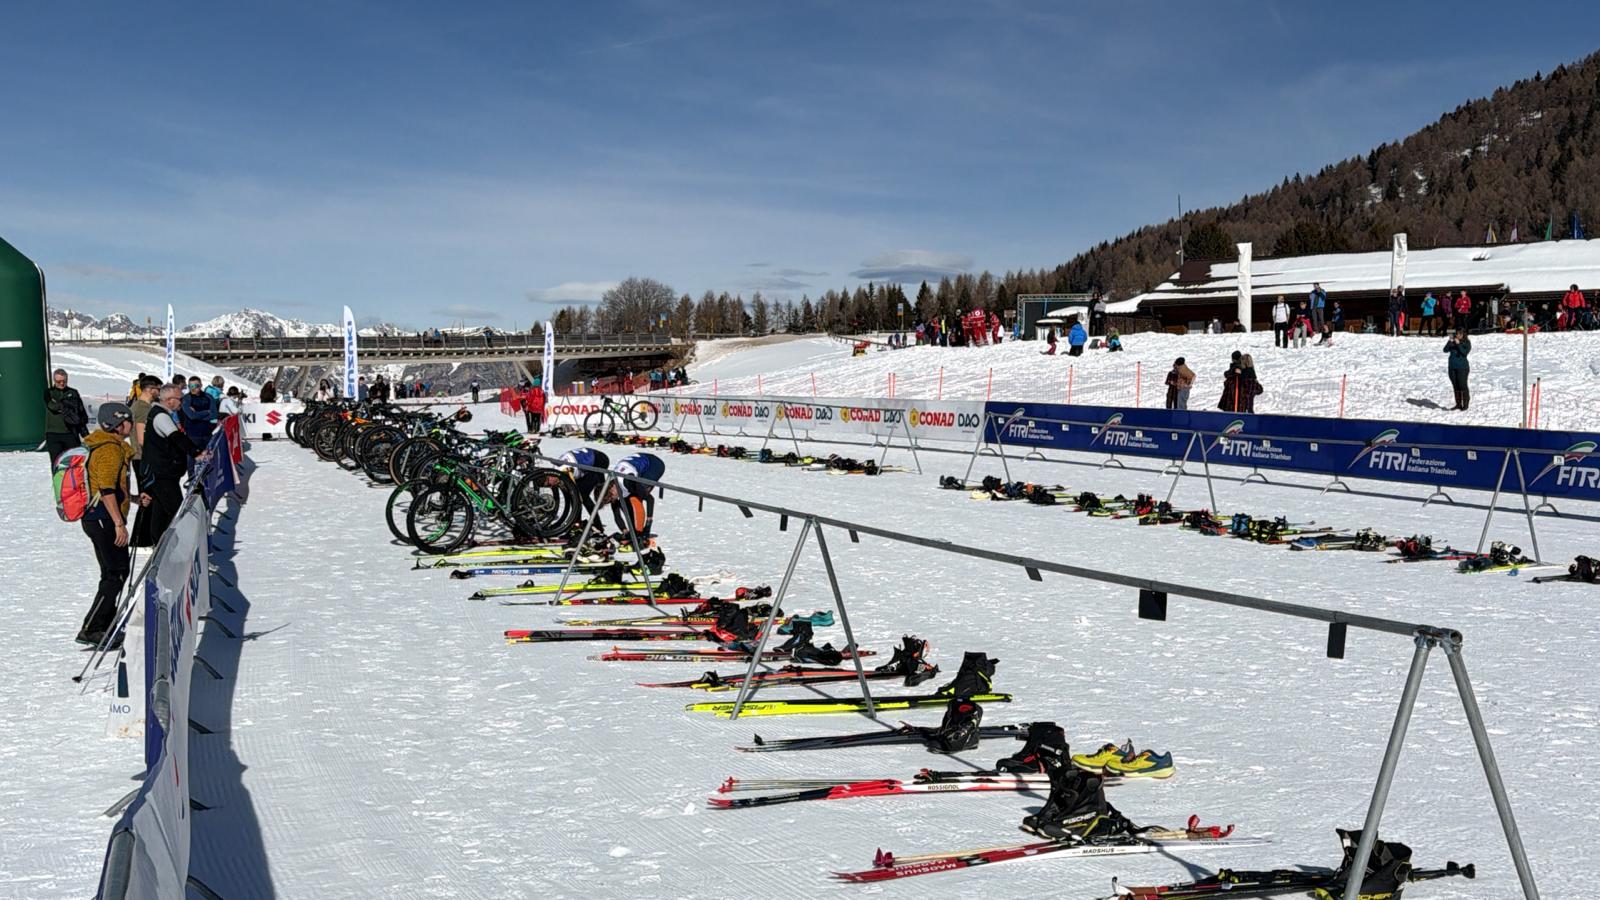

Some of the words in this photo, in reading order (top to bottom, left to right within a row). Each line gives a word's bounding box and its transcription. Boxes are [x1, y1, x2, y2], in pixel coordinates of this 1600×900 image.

[680, 403, 702, 416] CONAD
[729, 405, 753, 417] CONAD
[920, 412, 955, 427] CONAD
[1009, 424, 1029, 438] FITRI
[1104, 430, 1129, 447] FITRI
[1369, 450, 1408, 472] FITRI
[1408, 457, 1446, 467] Federazione
[1430, 466, 1457, 476] Triathlon
[1062, 811, 1097, 825] FISCHER
[895, 862, 957, 877] MADSHUS
